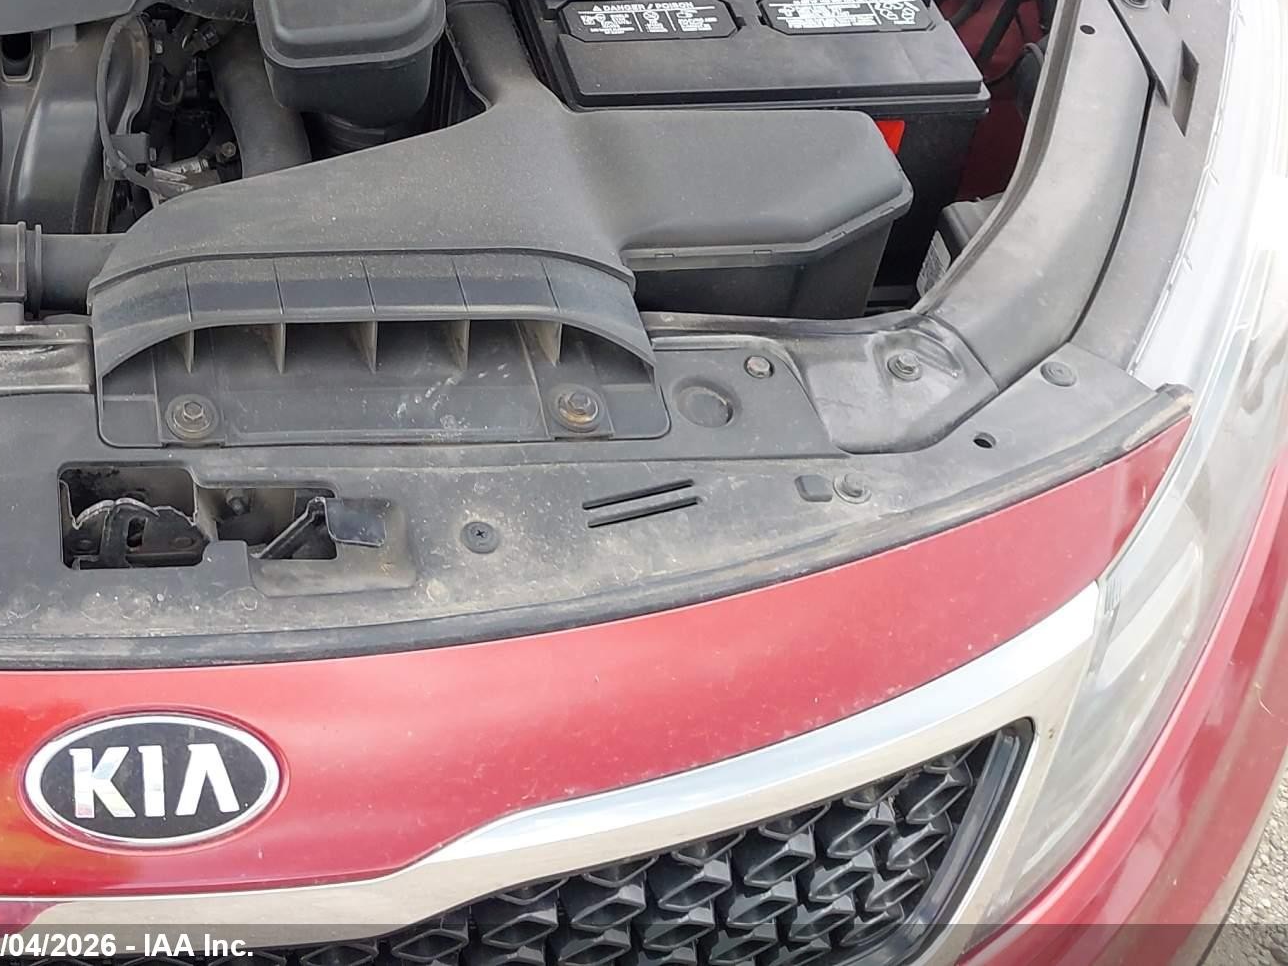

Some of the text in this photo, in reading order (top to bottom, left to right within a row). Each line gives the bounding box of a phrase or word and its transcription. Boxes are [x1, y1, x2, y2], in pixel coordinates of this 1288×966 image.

[602, 3, 646, 13] DANGER
[655, 1, 696, 10] POISON
[68, 743, 241, 819] KIA
